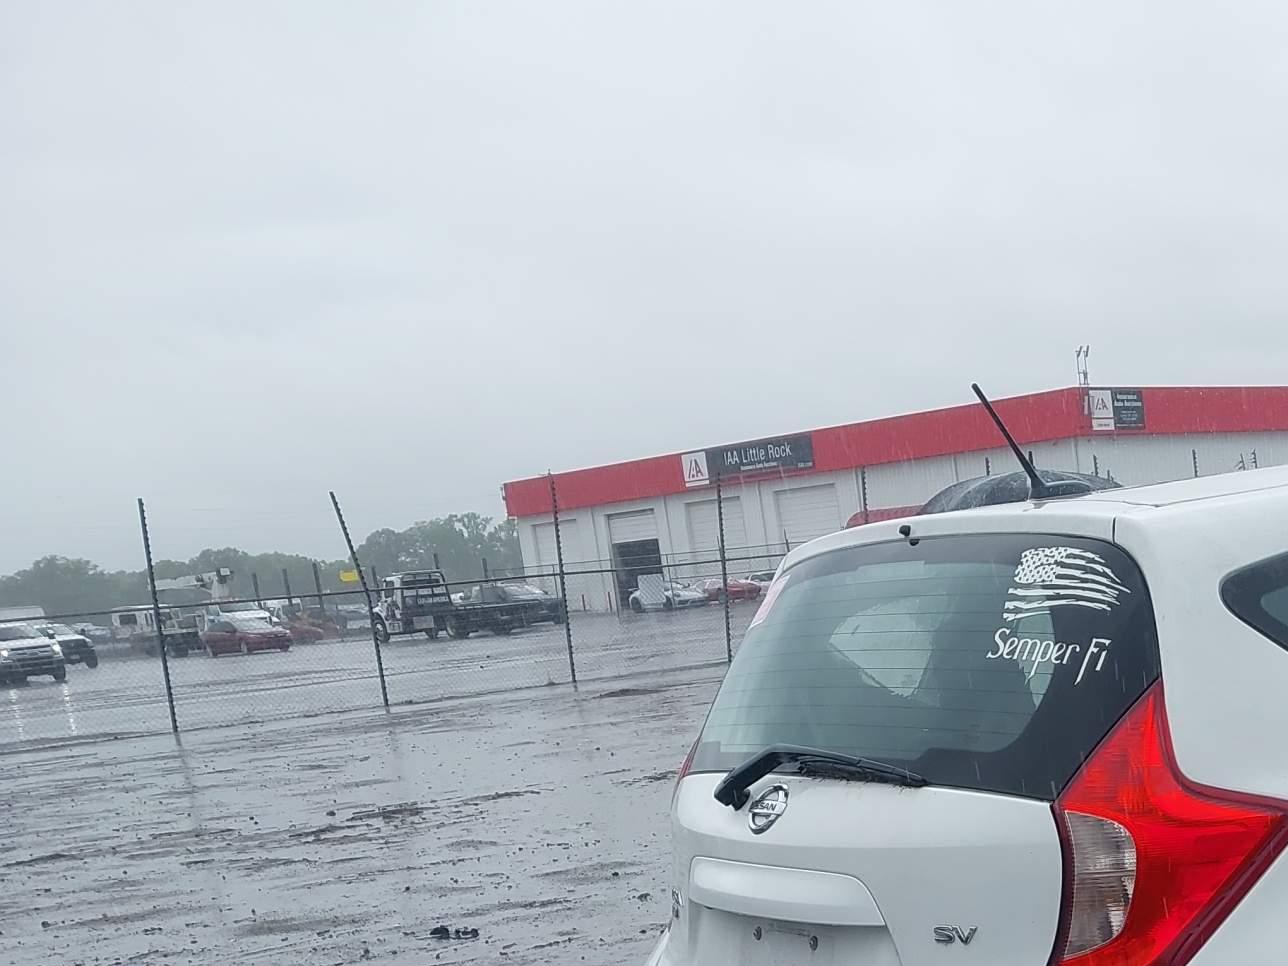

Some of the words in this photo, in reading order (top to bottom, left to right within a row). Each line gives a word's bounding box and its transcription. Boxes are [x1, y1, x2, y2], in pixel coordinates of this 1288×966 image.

[723, 449, 739, 465] IAA
[741, 446, 765, 463] Little
[767, 441, 792, 459] Rock
[986, 628, 1080, 685] Semper
[1074, 637, 1112, 685] Fi
[933, 925, 978, 945] SV
